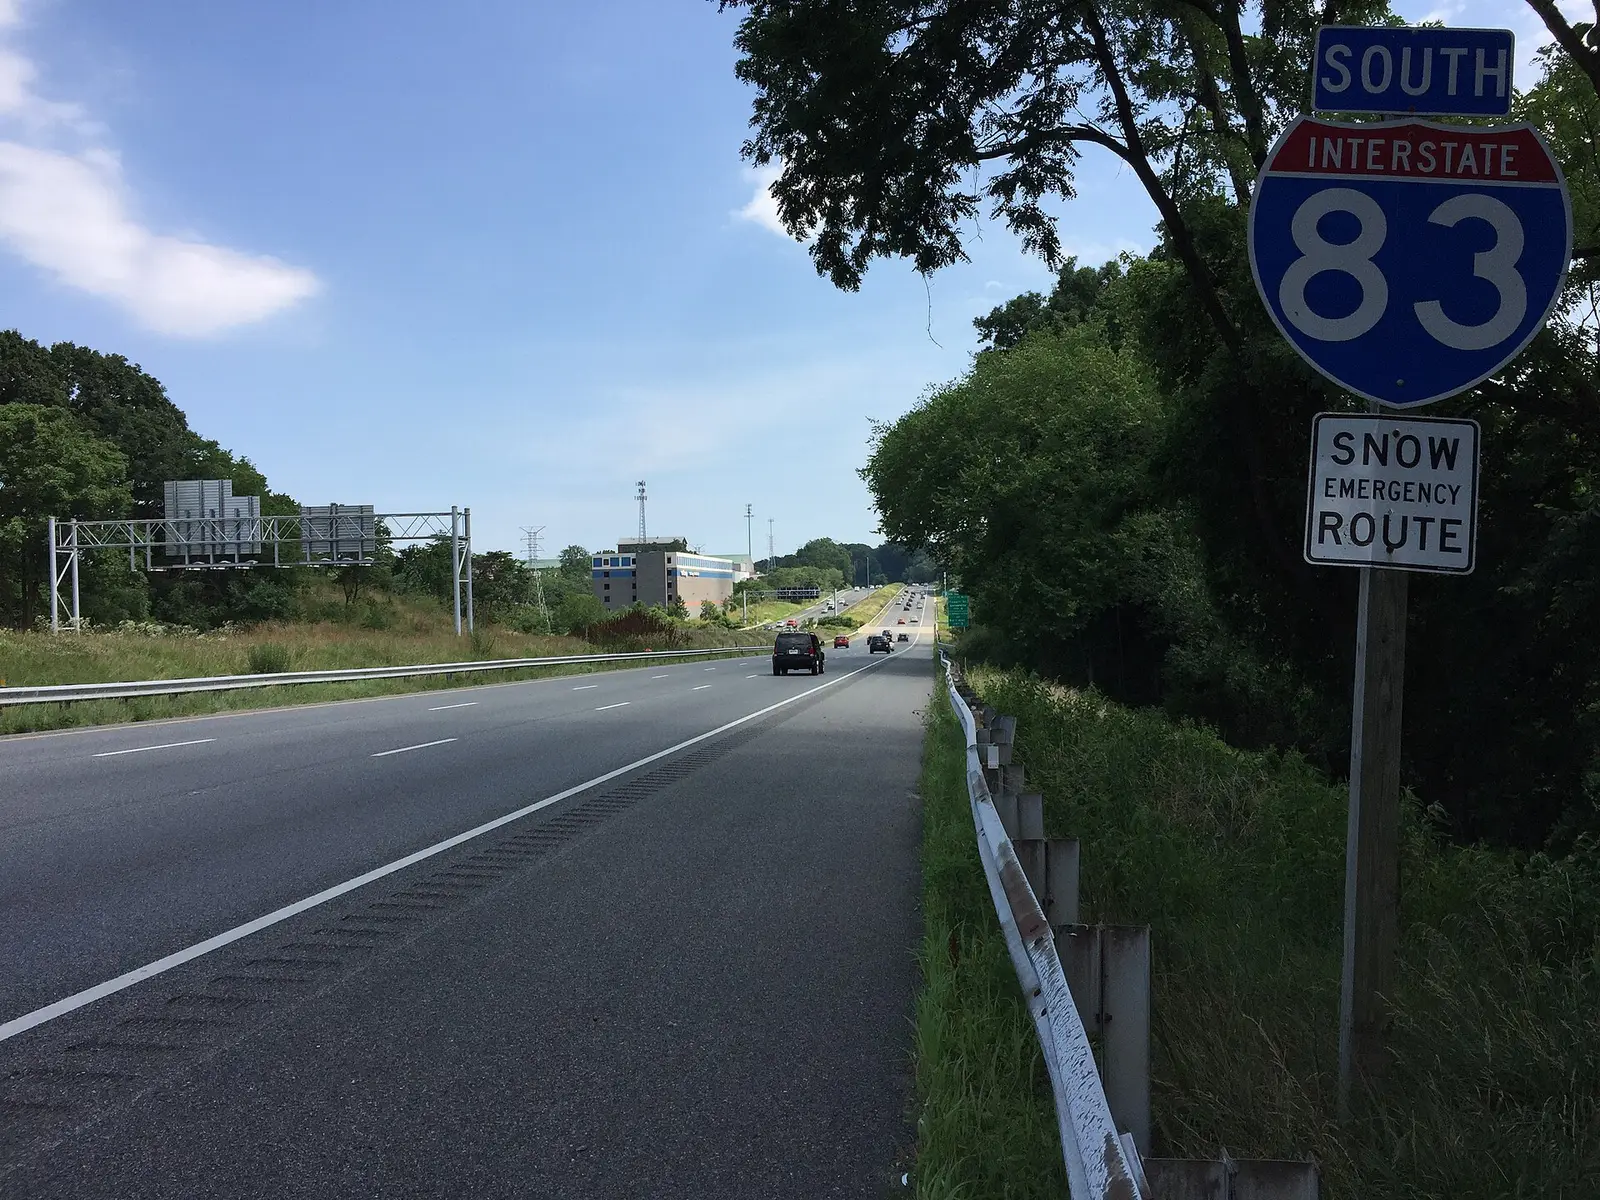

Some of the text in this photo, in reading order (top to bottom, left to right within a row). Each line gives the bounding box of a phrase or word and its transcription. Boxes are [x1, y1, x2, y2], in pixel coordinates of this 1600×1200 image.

[1321, 44, 1506, 98] SOUTH
[1309, 136, 1520, 176] INTERSTATE
[1279, 188, 1527, 351] 83
[1331, 431, 1460, 471] SNOW
[1324, 478, 1461, 505] EMERGENCY
[1318, 511, 1463, 554] ROUTE
